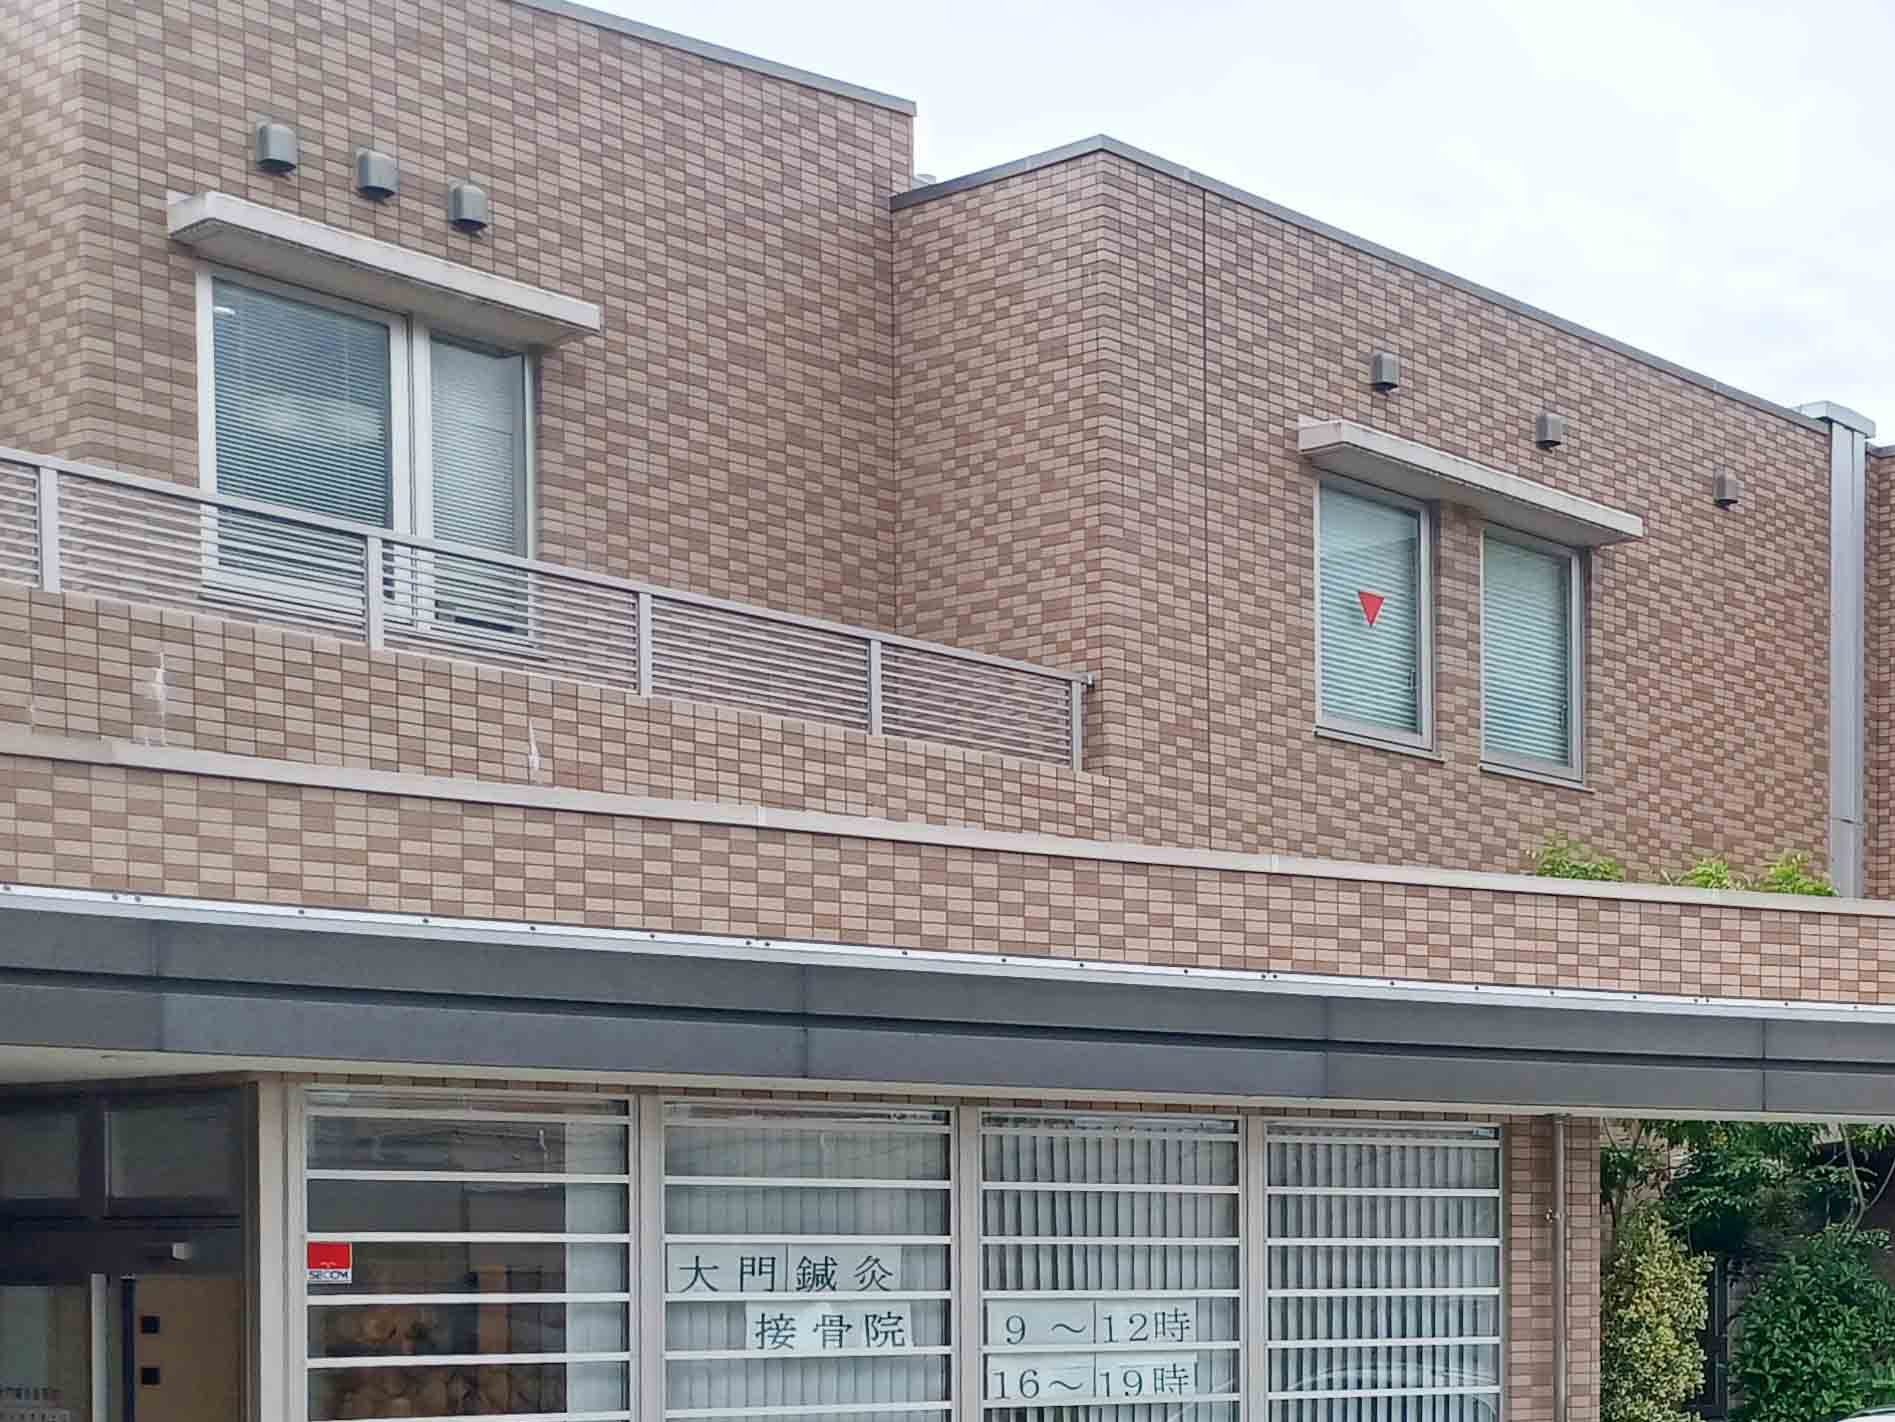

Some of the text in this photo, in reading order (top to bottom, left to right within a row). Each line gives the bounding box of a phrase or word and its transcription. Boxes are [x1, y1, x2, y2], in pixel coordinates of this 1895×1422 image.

[679, 1255, 894, 1293] 大門鍼灸
[755, 1311, 905, 1350] 接骨院
